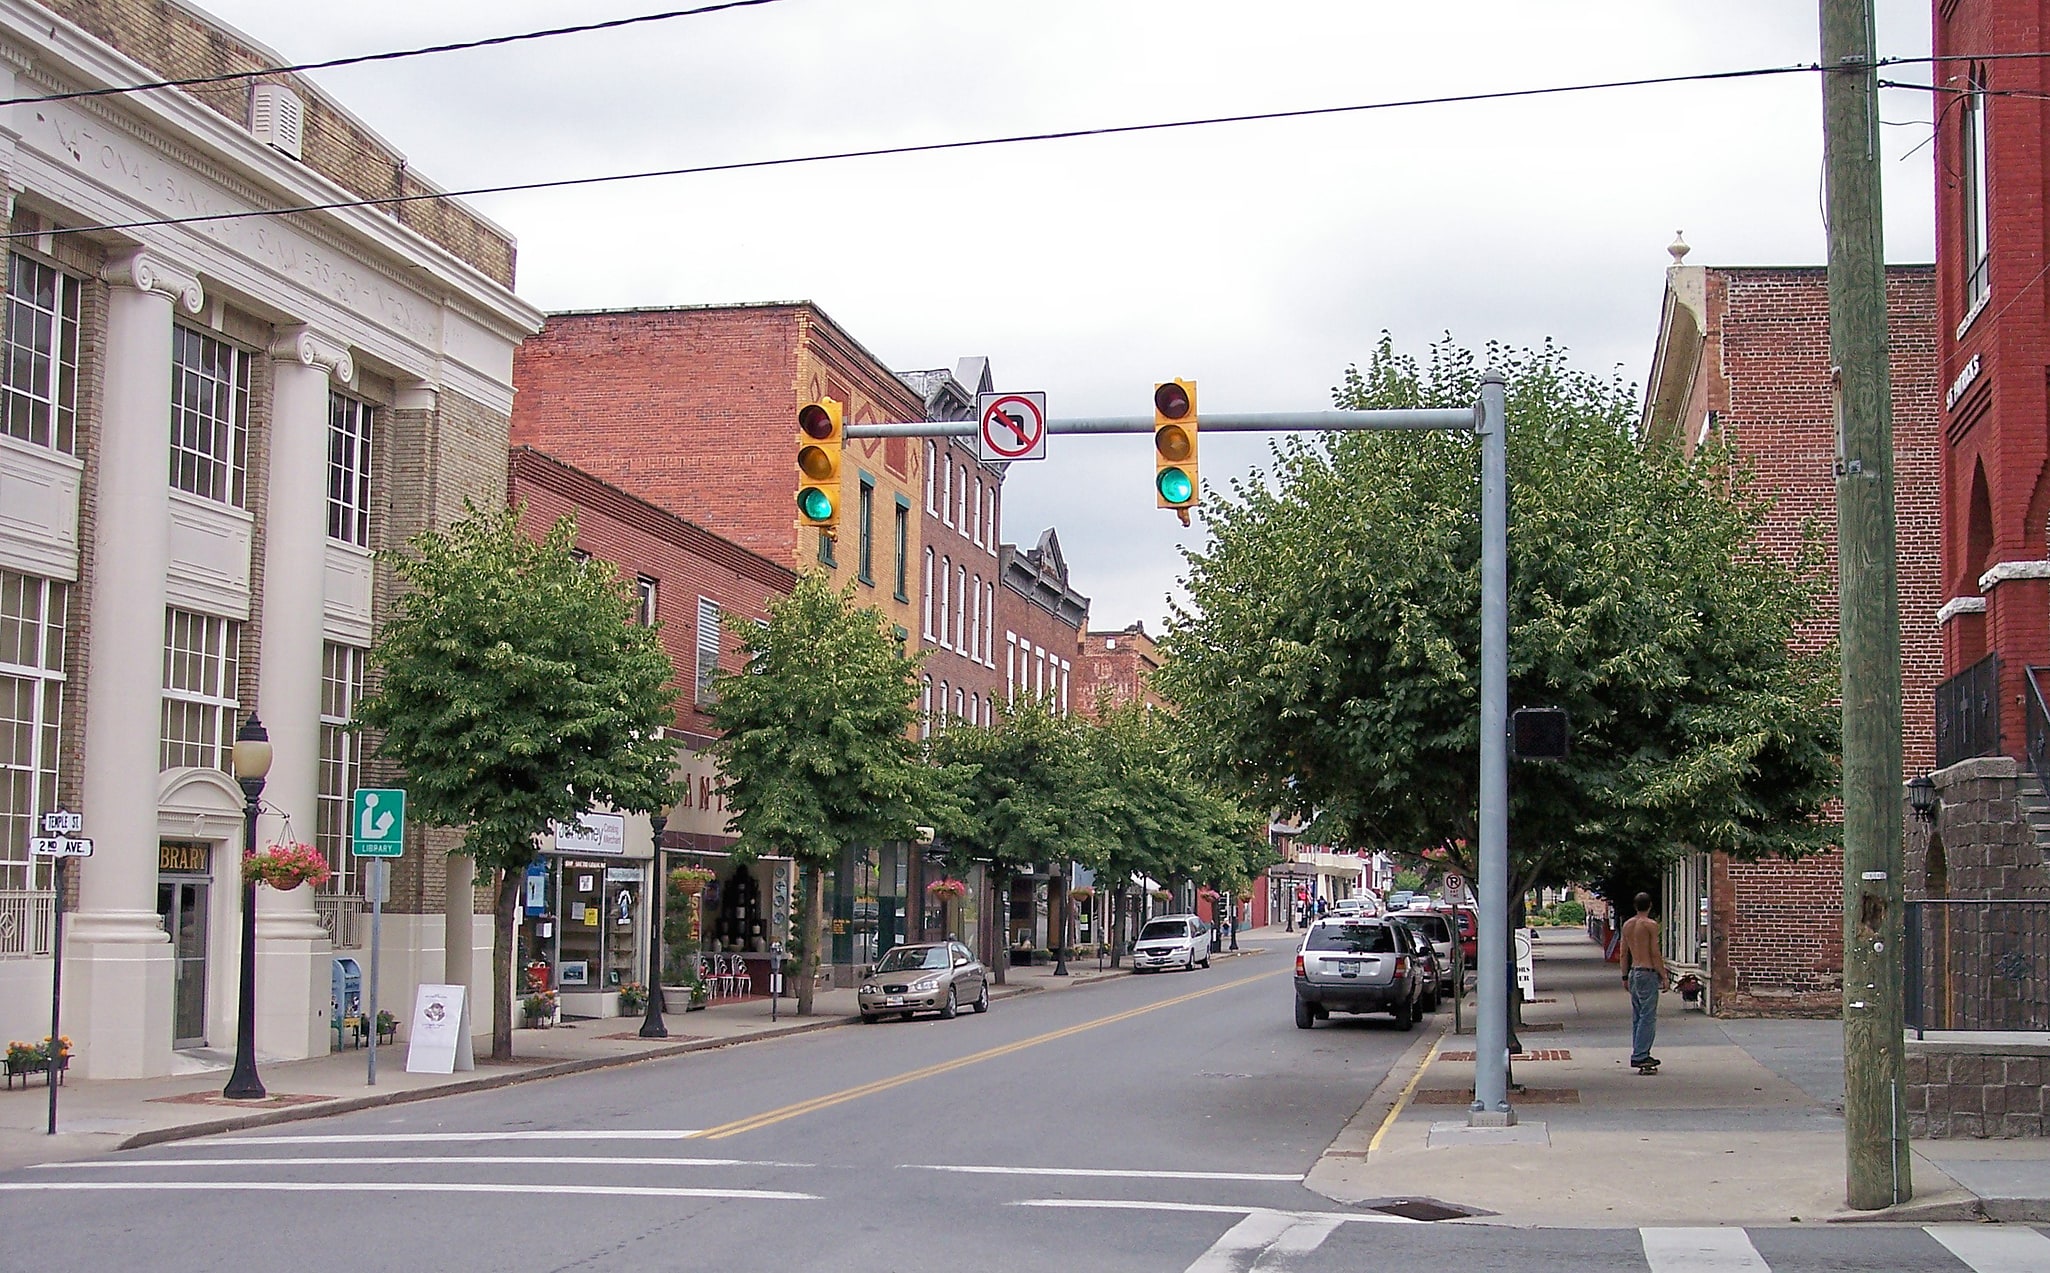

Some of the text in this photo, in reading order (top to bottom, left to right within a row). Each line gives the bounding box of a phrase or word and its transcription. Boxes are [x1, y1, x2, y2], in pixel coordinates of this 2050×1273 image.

[48, 815, 68, 829] TEMPLE
[361, 844, 393, 853] LIBRARY
[159, 845, 207, 870] BRARY
